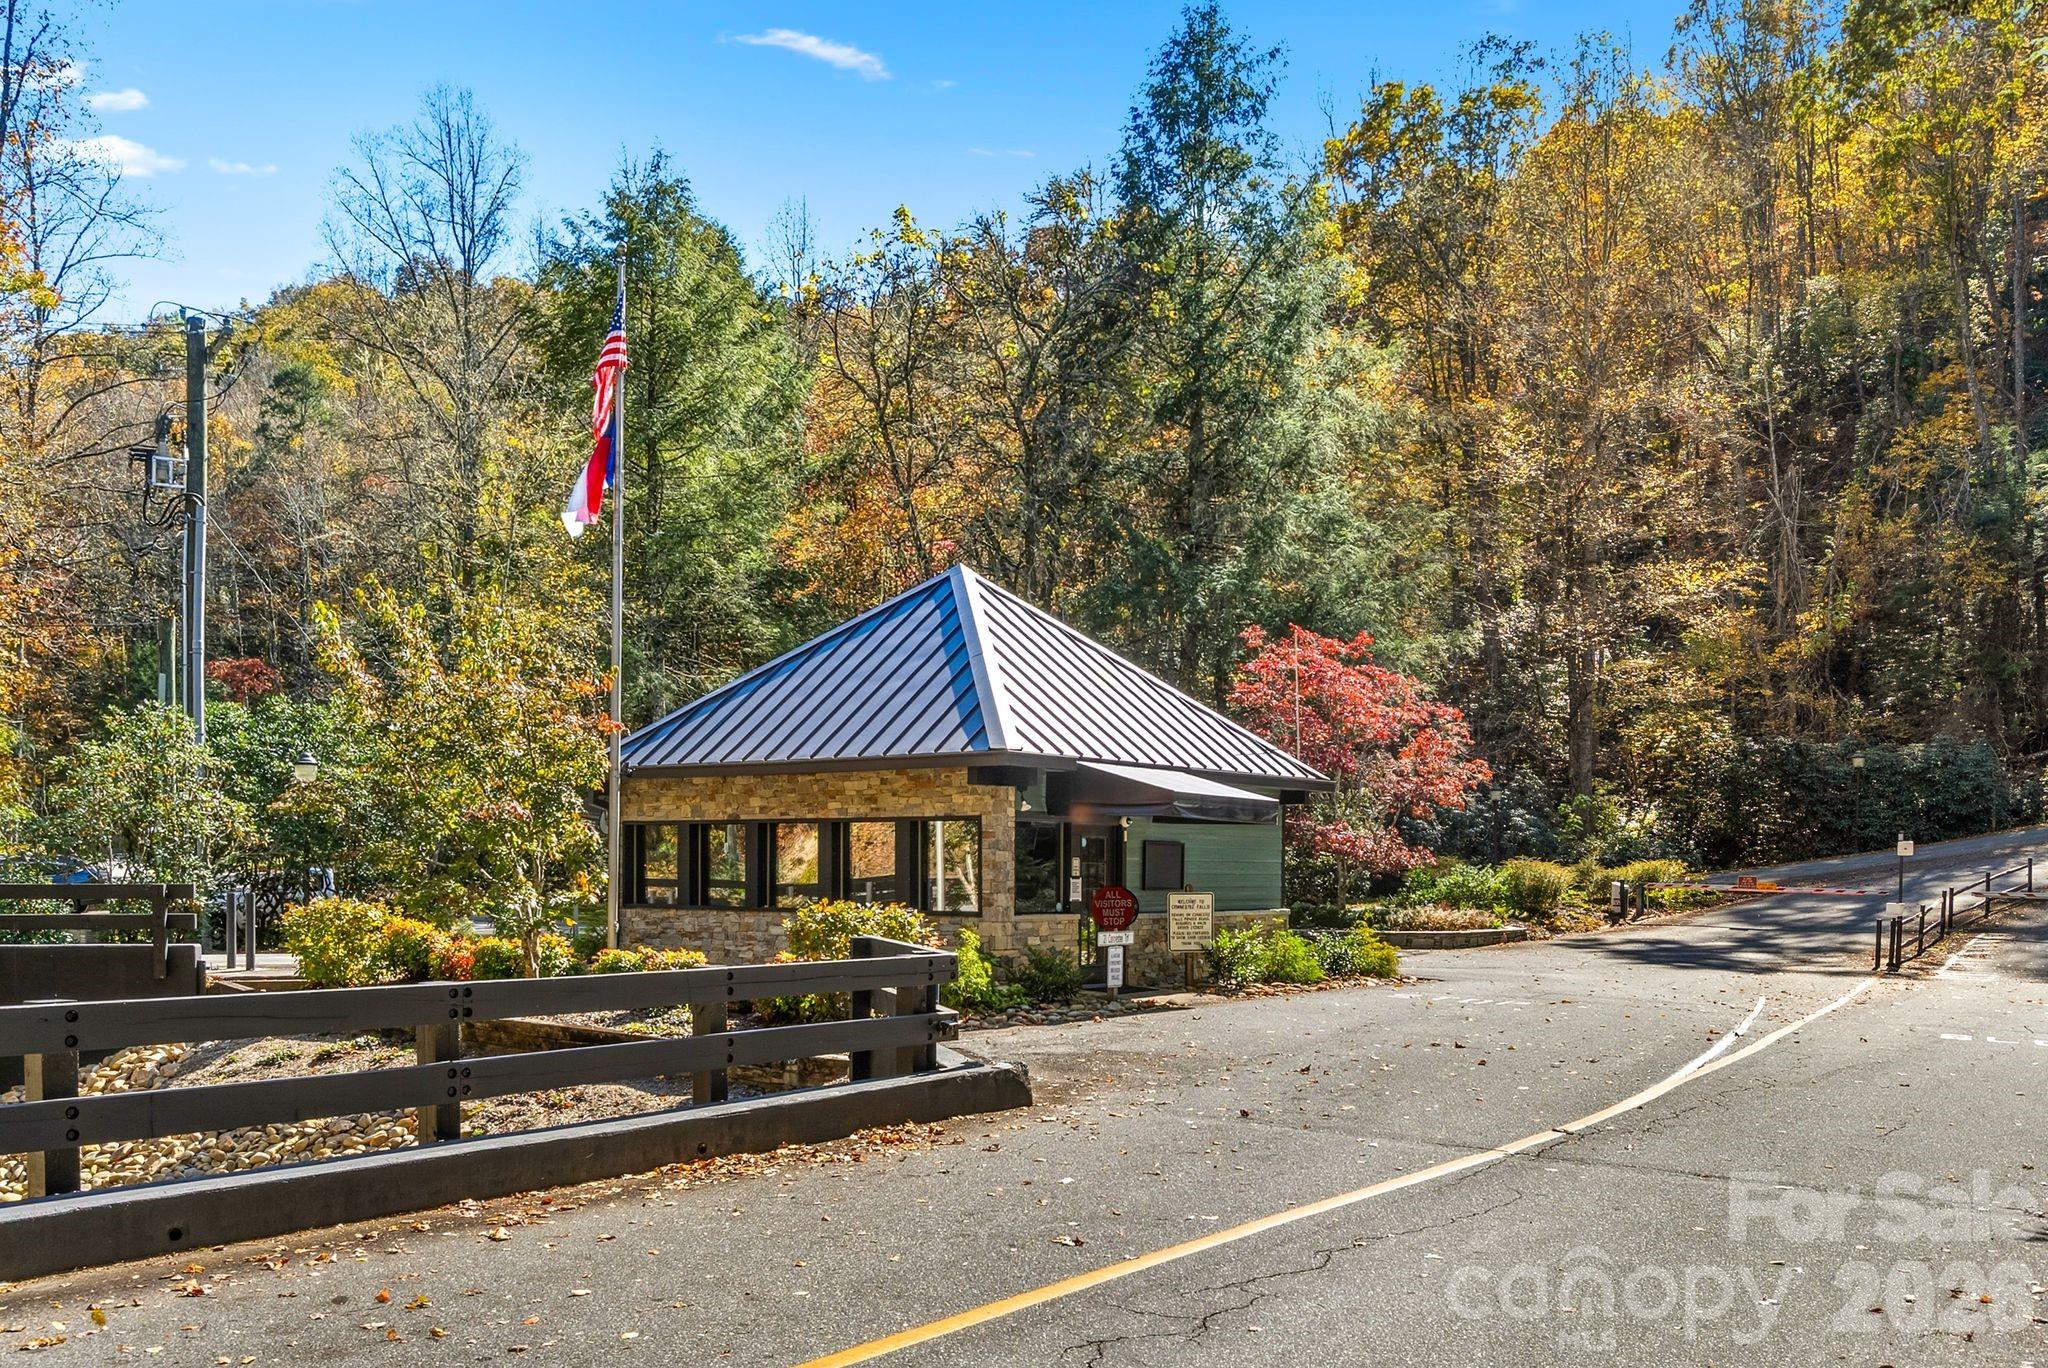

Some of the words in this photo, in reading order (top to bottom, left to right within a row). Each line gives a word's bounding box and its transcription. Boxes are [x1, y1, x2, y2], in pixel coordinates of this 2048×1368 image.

[1105, 891, 1121, 899] ALL
[1094, 899, 1132, 908] VISITORS
[1102, 908, 1125, 917] MUST
[1103, 917, 1125, 926] STOP
